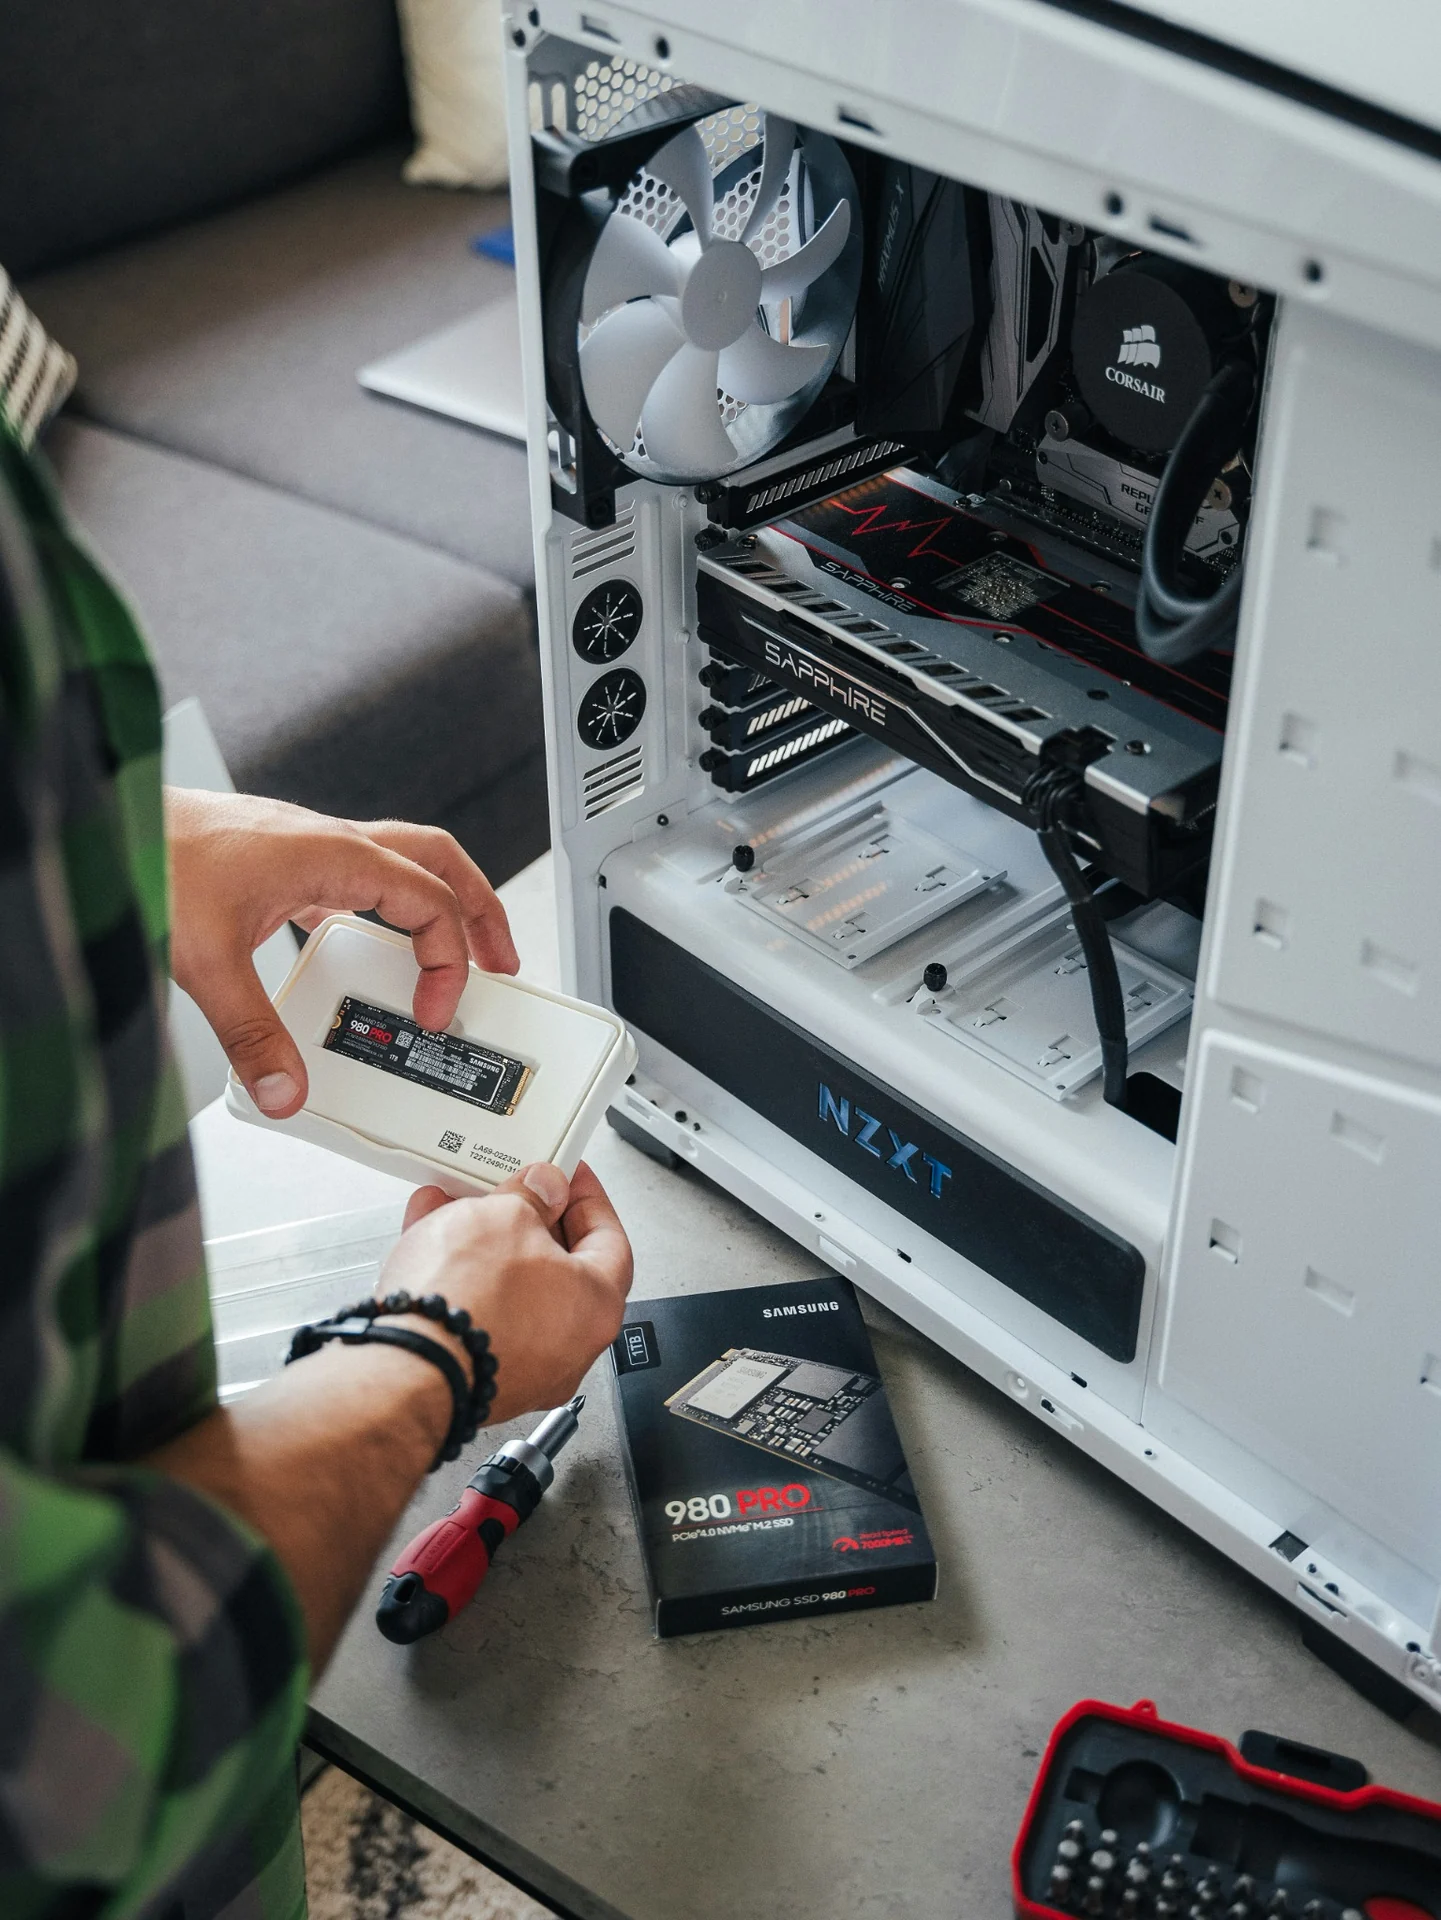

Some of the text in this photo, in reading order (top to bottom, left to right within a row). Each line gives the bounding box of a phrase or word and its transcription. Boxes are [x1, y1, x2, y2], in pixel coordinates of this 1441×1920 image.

[1105, 366, 1165, 404] CORSAIR
[820, 561, 917, 612] SAPPHIRE
[765, 641, 886, 726] SAPPHIRE
[350, 1020, 370, 1034] 980
[369, 1026, 392, 1043] PRO
[469, 1057, 500, 1074] SAMSUNG
[819, 1082, 952, 1199] NZXT
[469, 1151, 521, 1173] T2212490131
[473, 1143, 521, 1166] LA69-02233A
[763, 1301, 839, 1318] SAMSUNG
[629, 1335, 643, 1357] 1TB
[665, 1483, 811, 1525] 980 PRO
[753, 1520, 772, 1530] M.2
[773, 1518, 794, 1528] SSD
[721, 1586, 875, 1615] SAMSUNG SSD 980 PRO
